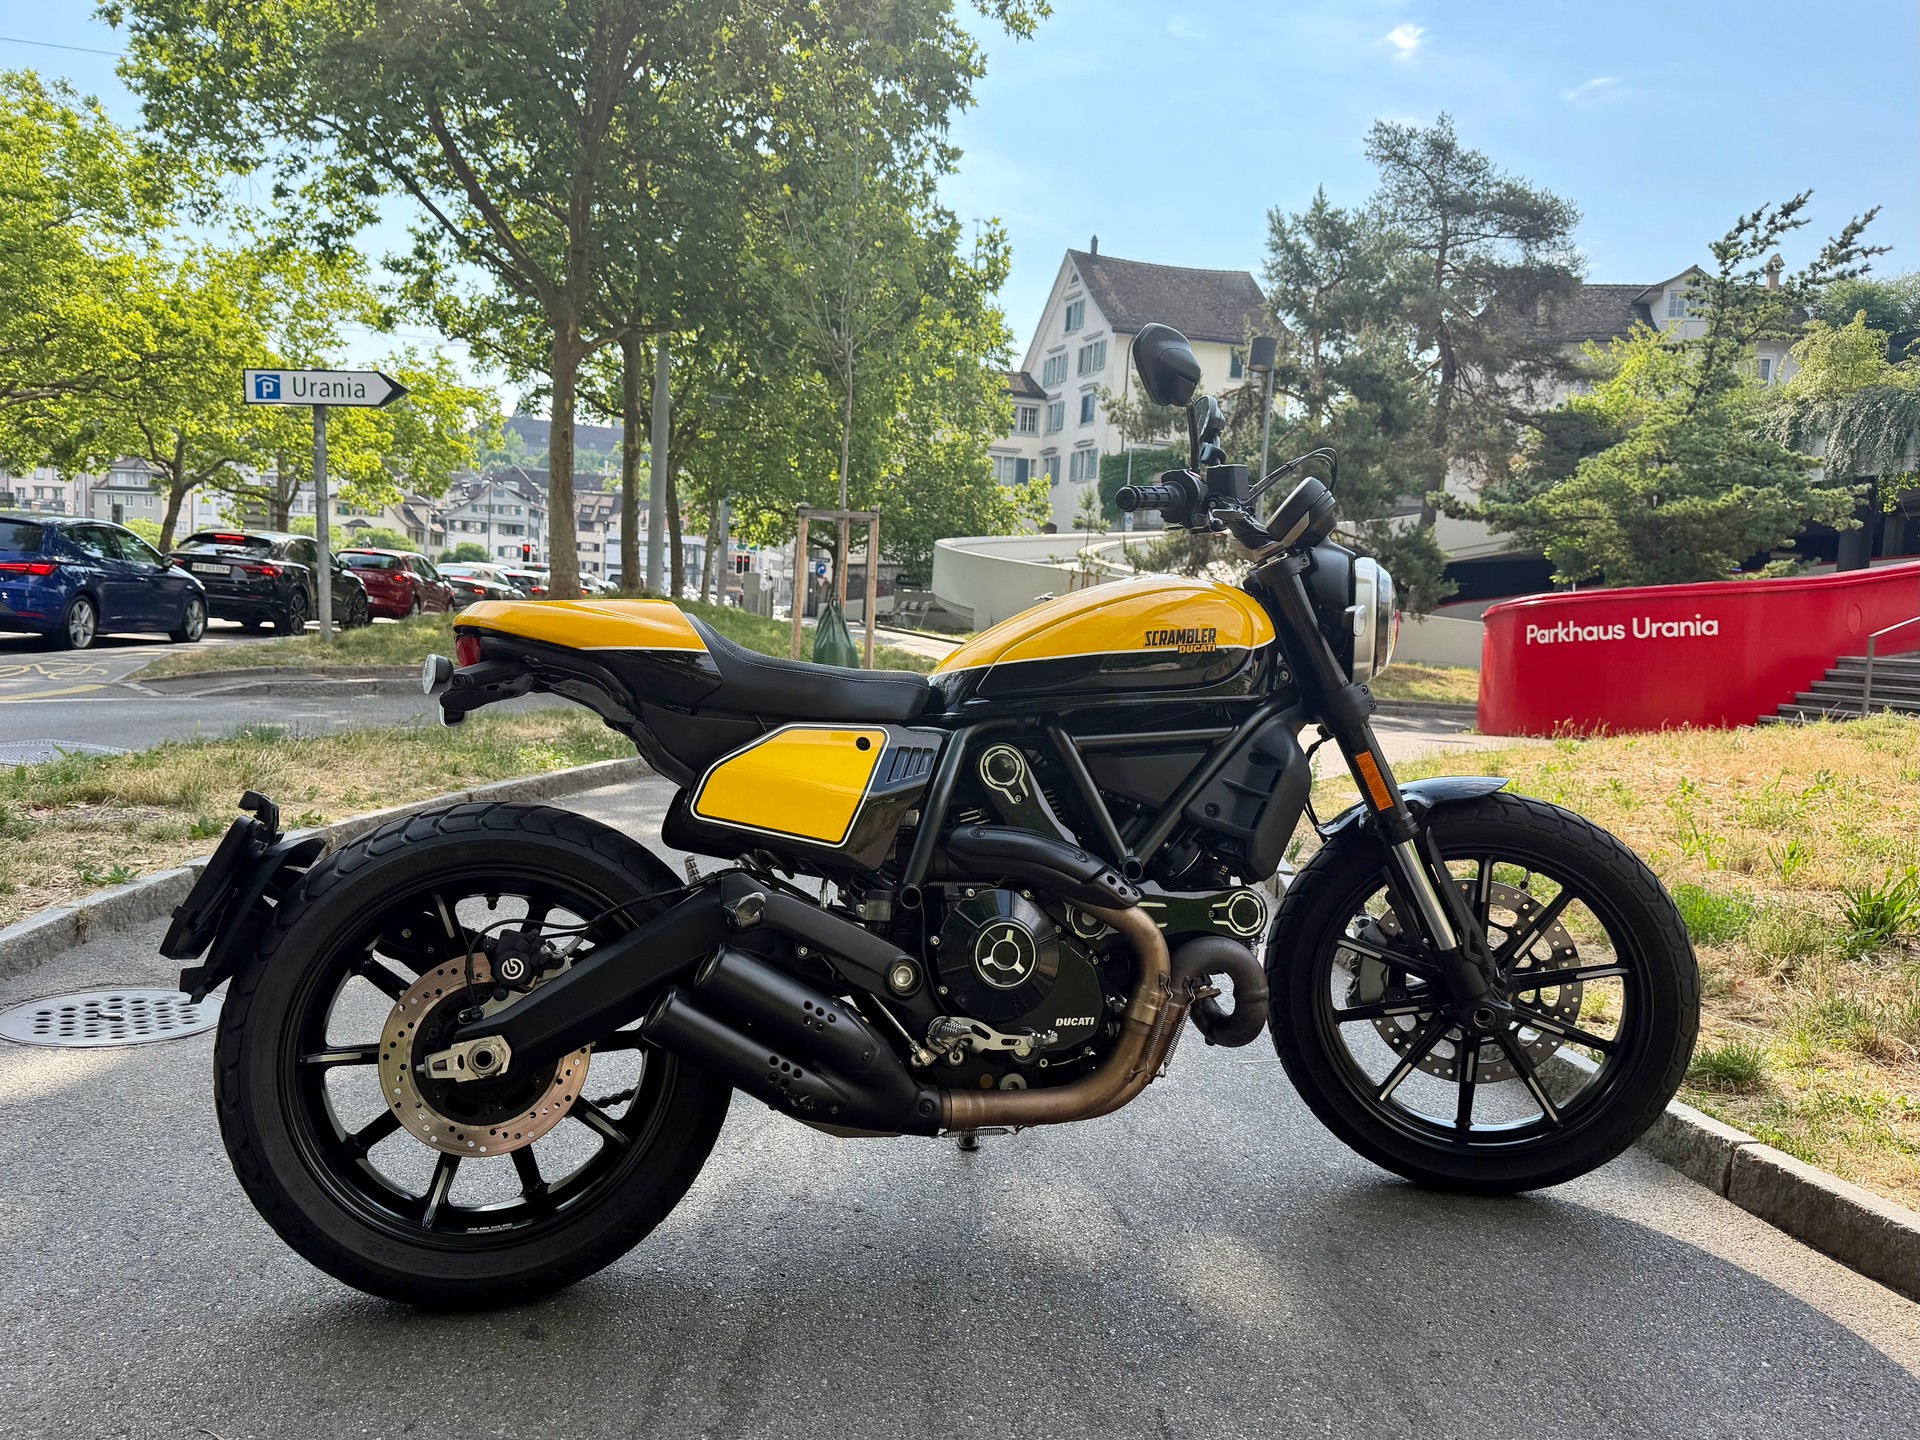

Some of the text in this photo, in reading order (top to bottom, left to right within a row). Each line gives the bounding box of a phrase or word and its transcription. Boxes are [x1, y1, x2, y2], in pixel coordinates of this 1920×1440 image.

[293, 376, 366, 398] Urania
[1145, 628, 1217, 647] SCRAMBLER
[1526, 613, 1719, 645] Parkhaus Urania
[1179, 643, 1216, 654] DUCATI
[1055, 1016, 1095, 1027] DUCATI
